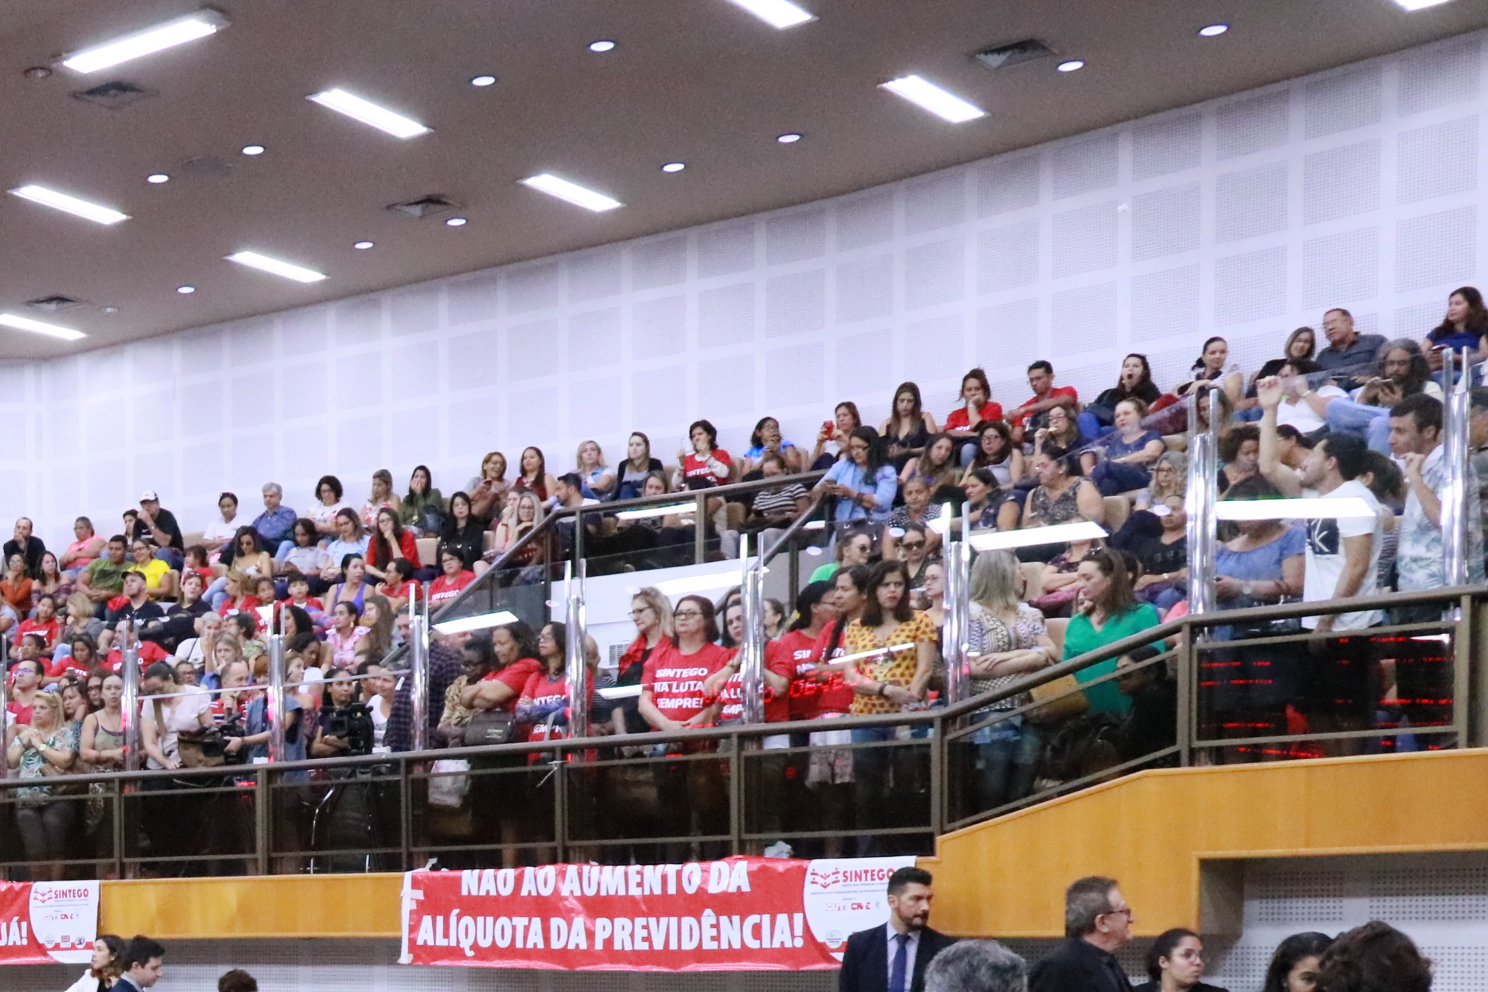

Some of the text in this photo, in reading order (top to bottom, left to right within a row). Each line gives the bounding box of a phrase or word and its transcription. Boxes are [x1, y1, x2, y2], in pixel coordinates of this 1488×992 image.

[655, 667, 708, 678] SINTEGO
[654, 680, 704, 693] NA LUTA
[656, 697, 703, 709] SEMPRE!
[520, 865, 556, 897] AO
[561, 862, 702, 897] AUMENTO
[707, 860, 751, 894] DA
[54, 888, 89, 899] SINTEGO
[416, 908, 805, 957] ALÍQUOTA DA PREVIDÊNCIA!
